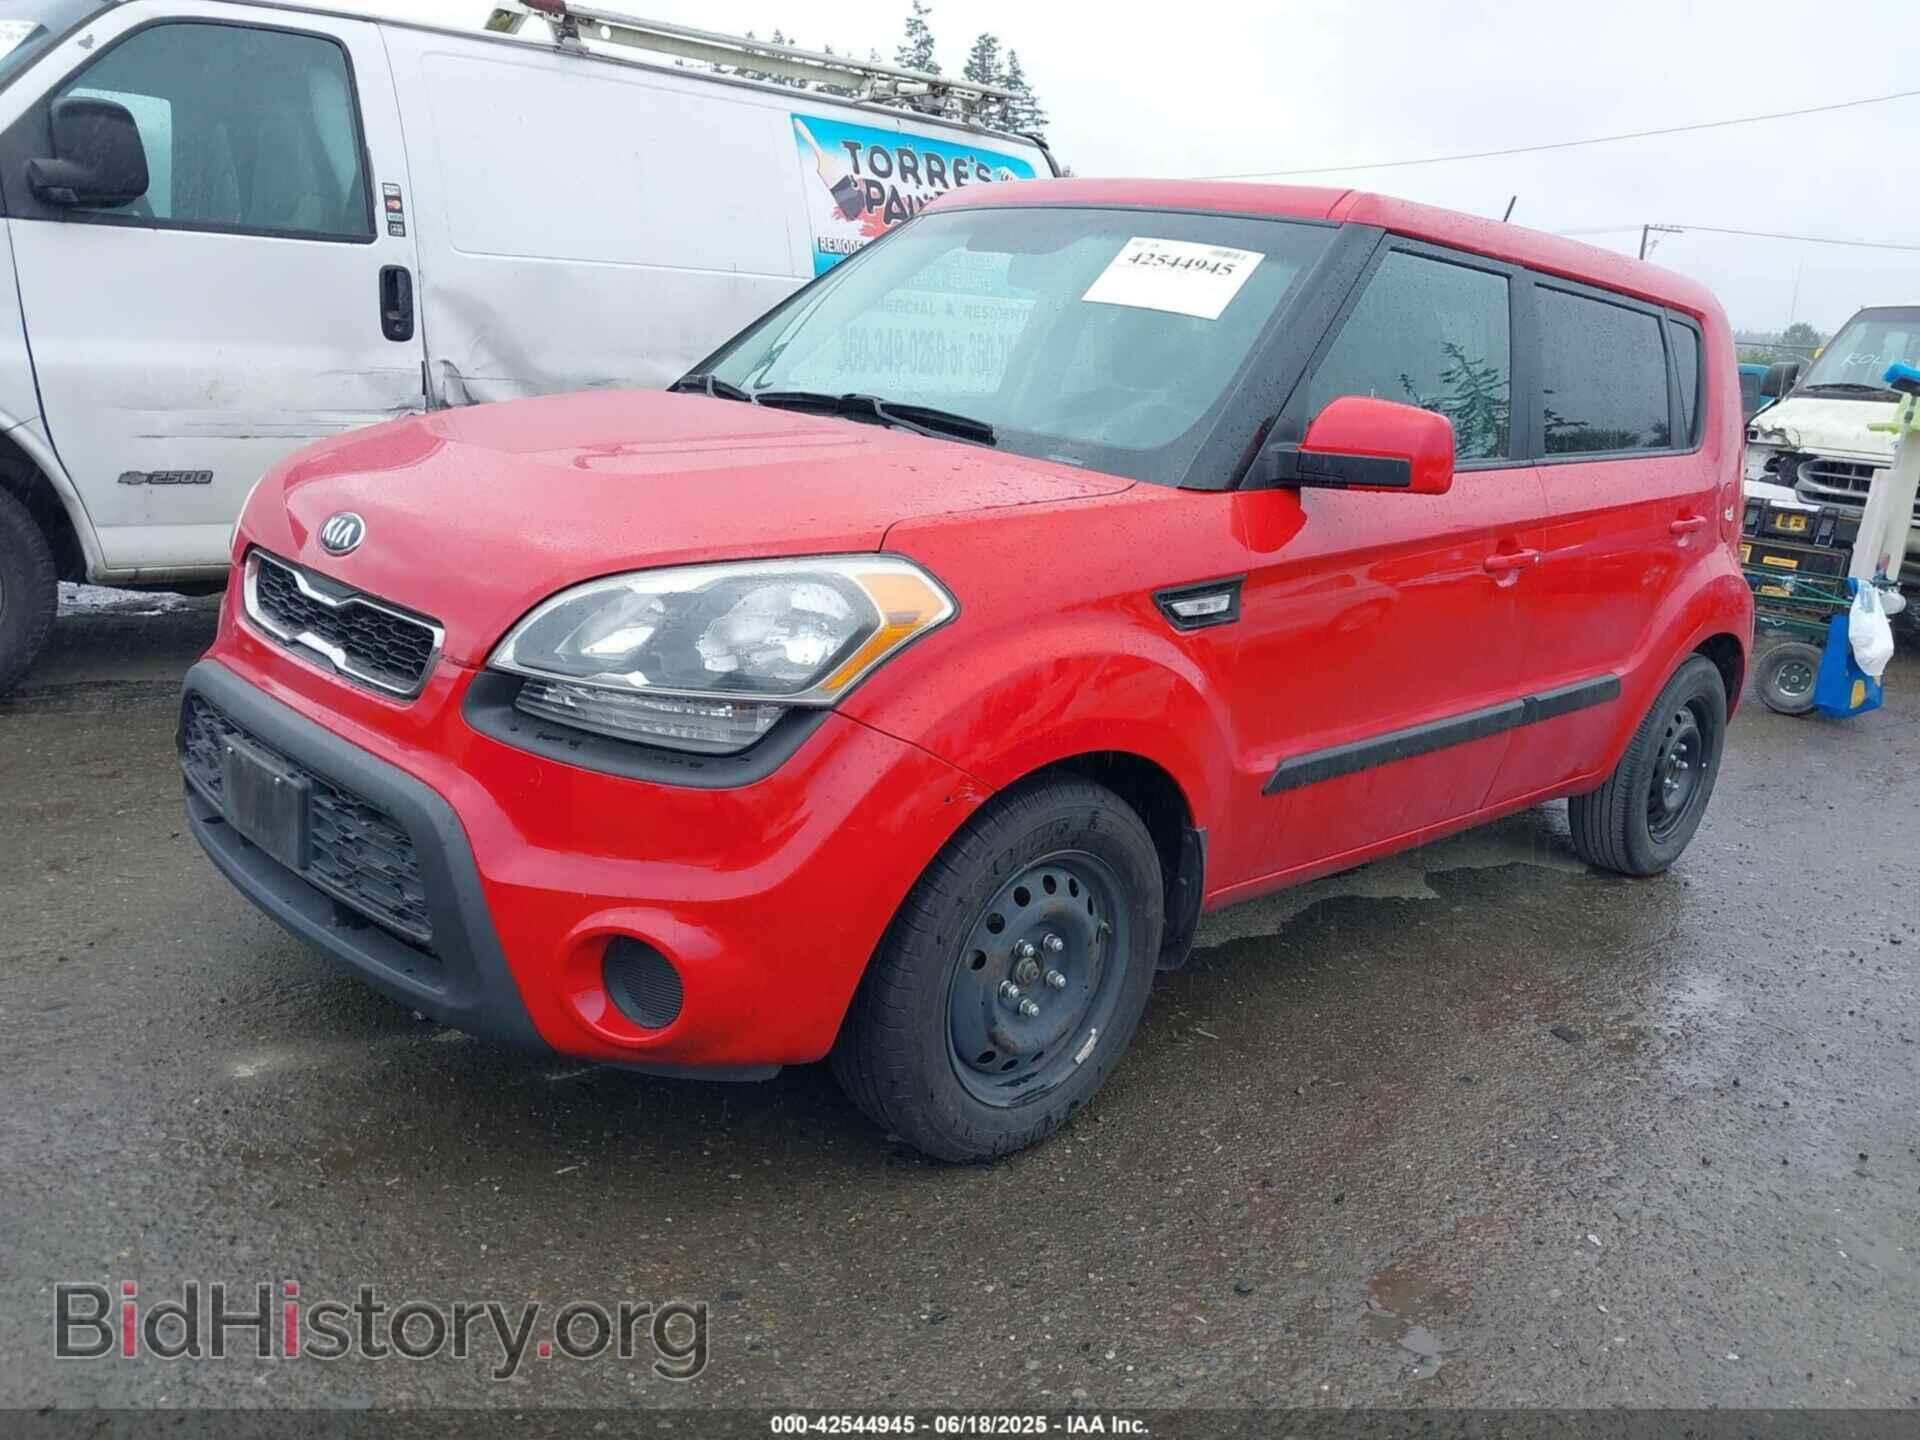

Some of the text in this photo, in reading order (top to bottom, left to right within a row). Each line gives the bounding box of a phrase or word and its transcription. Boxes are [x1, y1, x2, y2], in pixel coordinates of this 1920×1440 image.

[842, 140, 993, 189] TORRE'S
[1128, 252, 1237, 276] 42544945
[149, 471, 213, 484] 2500
